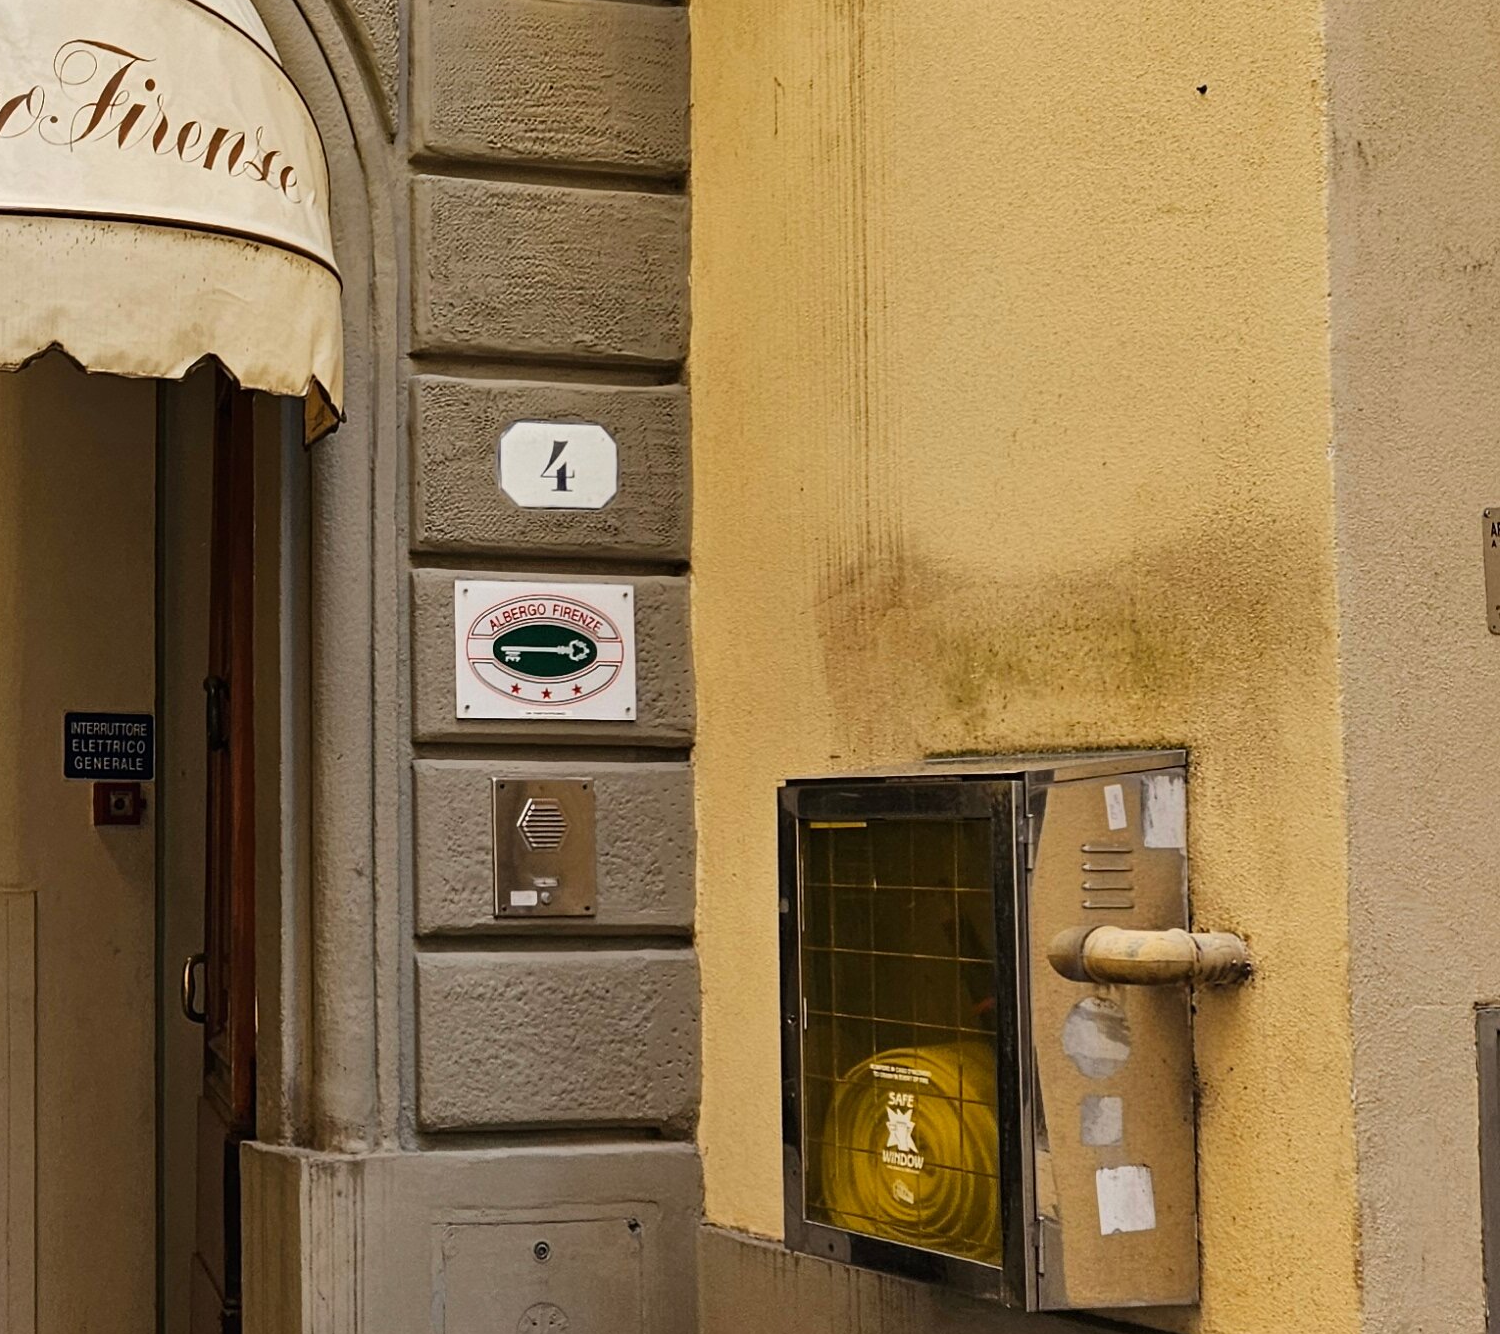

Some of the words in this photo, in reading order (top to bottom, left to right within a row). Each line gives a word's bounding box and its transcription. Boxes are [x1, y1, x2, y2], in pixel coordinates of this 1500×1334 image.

[38, 39, 302, 204] Firenze
[540, 440, 575, 492] 4
[489, 603, 547, 632] ALBERGO
[552, 603, 604, 633] FIRENZE
[71, 722, 148, 736] INTERRUTTORE
[72, 739, 146, 754] ELETTRICO
[74, 756, 144, 771] GENERALE
[888, 1091, 915, 1108] SAFE
[882, 1149, 925, 1169] WINDOW
